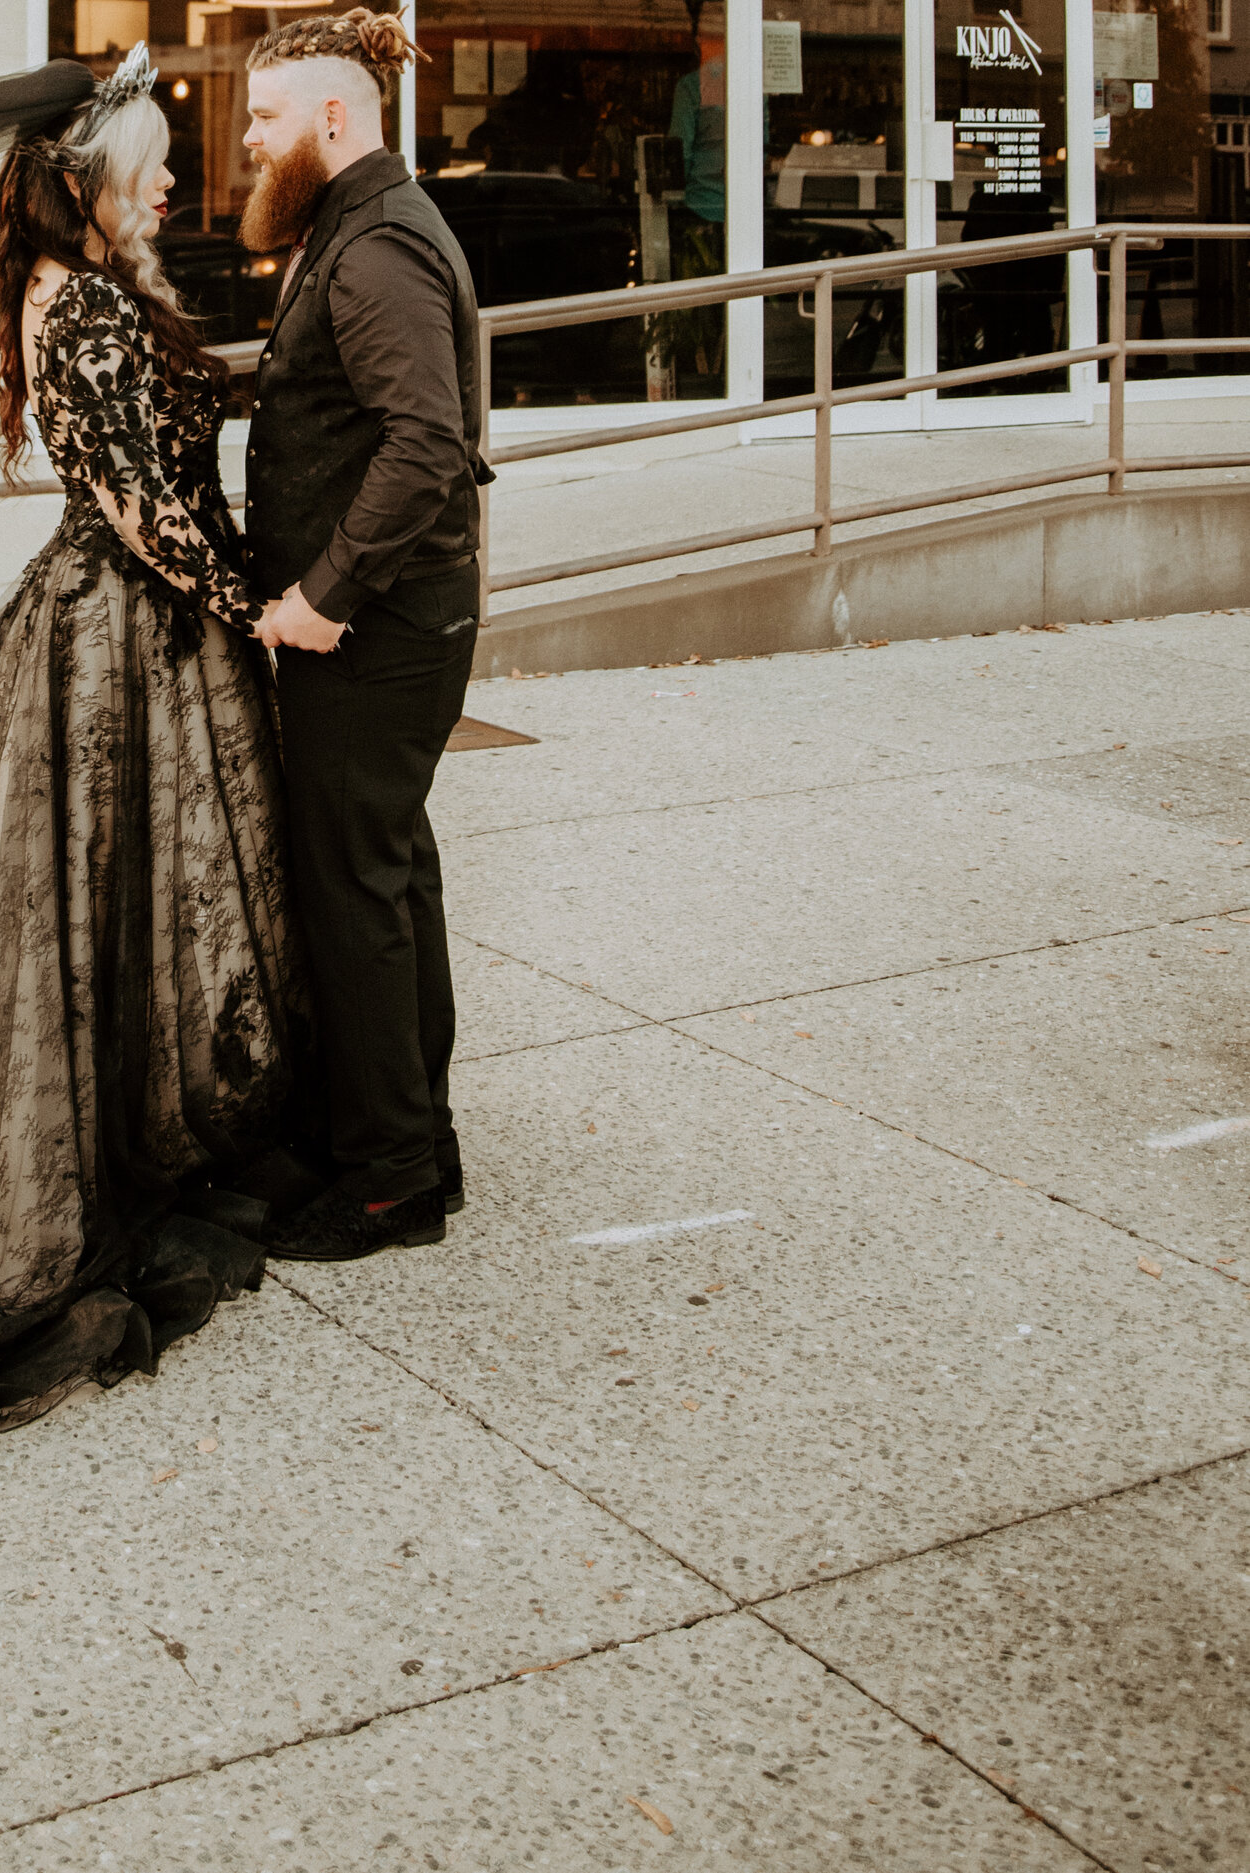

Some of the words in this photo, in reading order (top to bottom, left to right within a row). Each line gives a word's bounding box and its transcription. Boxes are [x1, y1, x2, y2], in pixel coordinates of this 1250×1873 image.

[956, 26, 1011, 60] KINJO
[960, 107, 986, 122] HOURS
[986, 108, 997, 122] OF
[998, 108, 1040, 122] OPERATION
